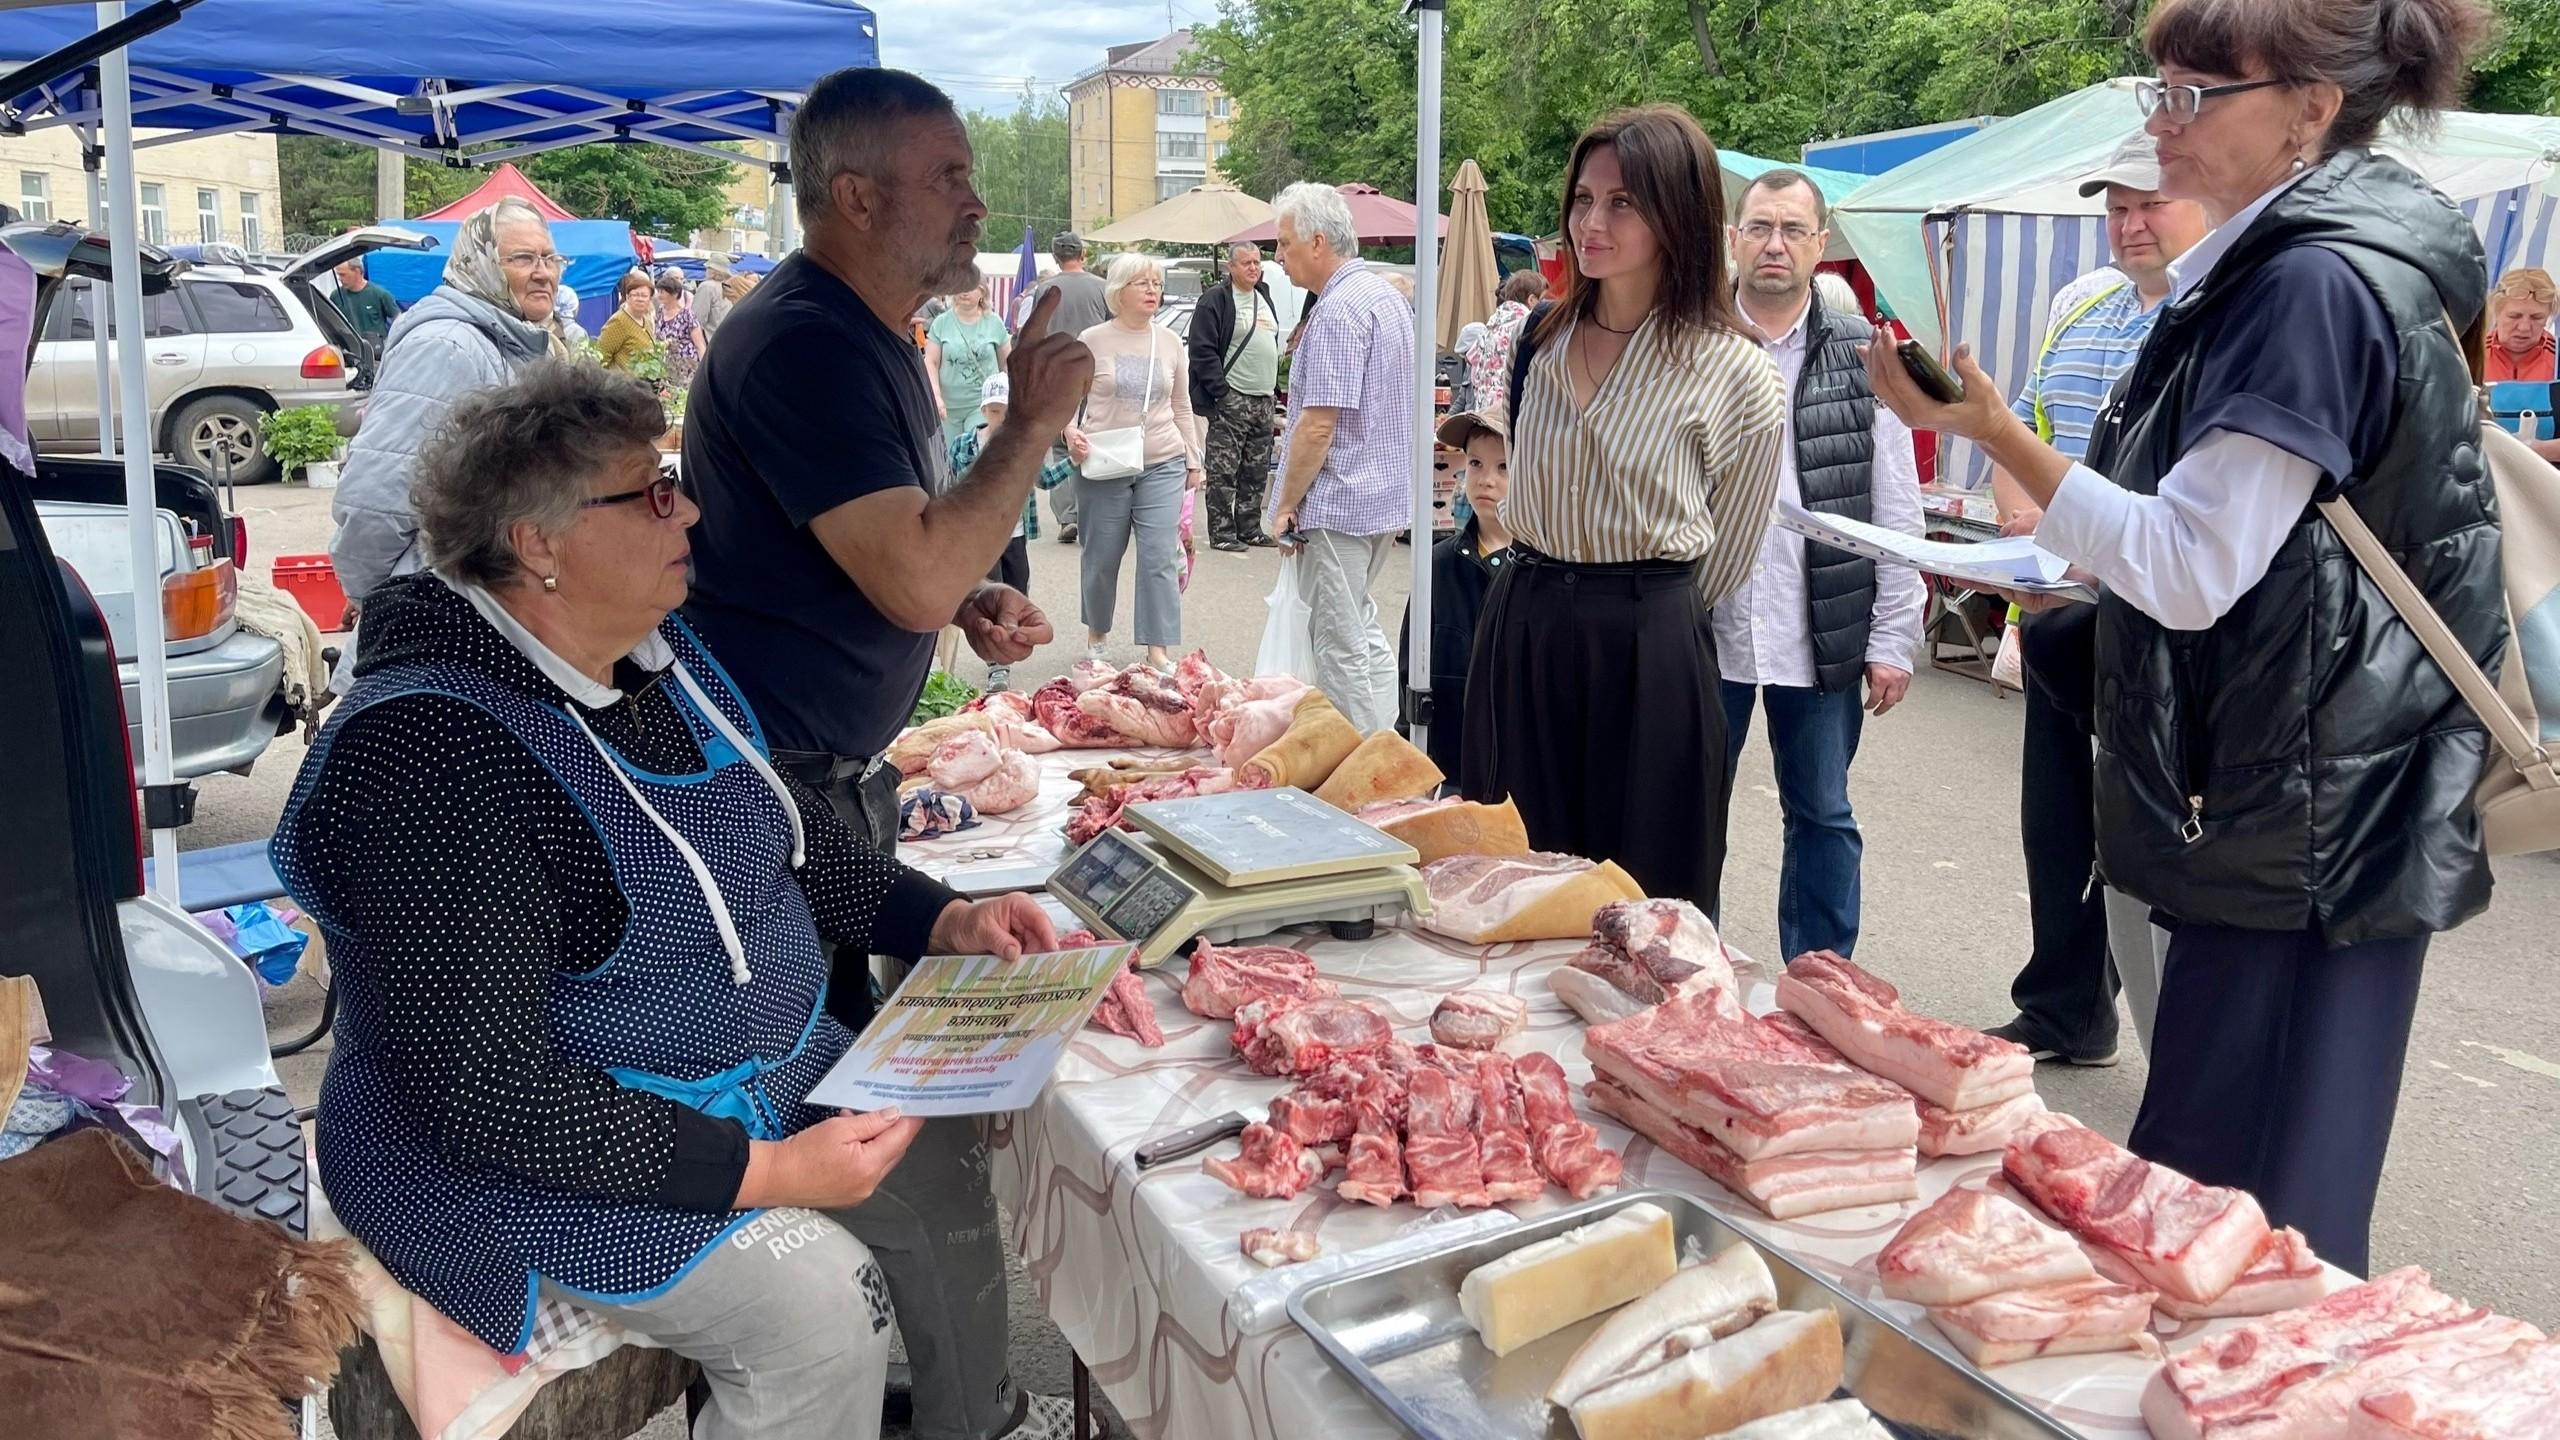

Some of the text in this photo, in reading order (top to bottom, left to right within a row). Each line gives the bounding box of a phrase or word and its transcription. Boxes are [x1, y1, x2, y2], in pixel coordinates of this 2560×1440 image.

[895, 996, 1009, 1010] Владимирович
[1009, 989, 1091, 1009] Александр
[946, 1014, 1013, 1029] Мальцев
